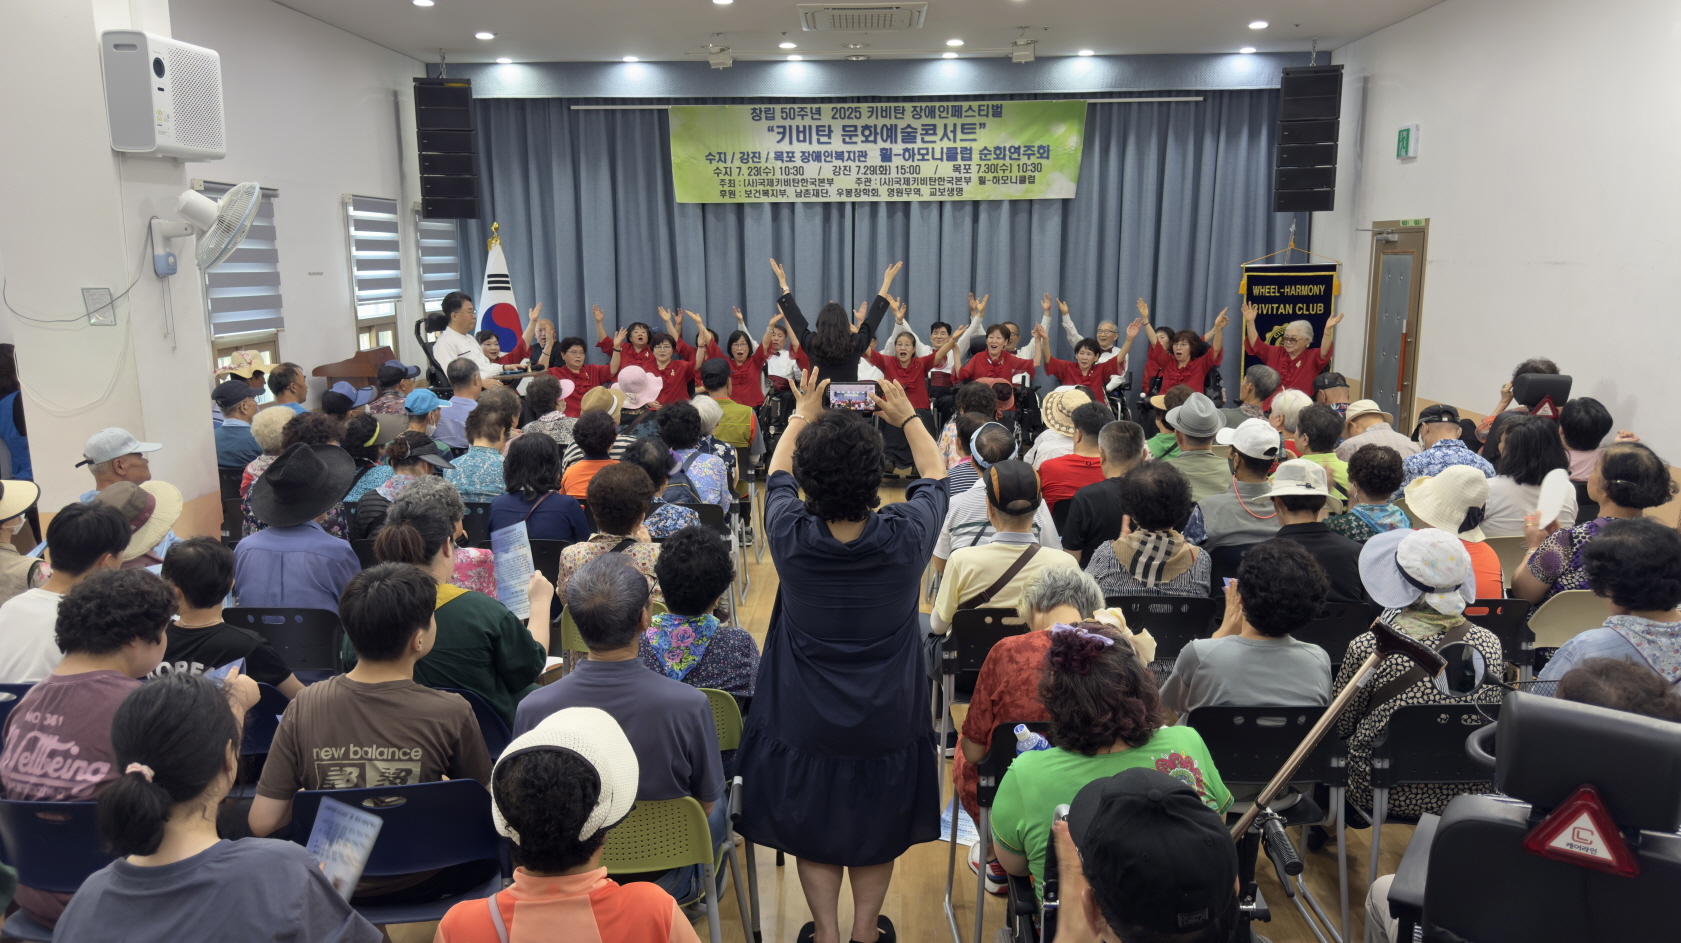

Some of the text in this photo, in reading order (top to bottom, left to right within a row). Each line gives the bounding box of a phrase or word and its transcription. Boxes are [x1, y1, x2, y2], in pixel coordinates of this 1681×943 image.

[750, 103, 1003, 121] 창립 50주년 2025 키비탄 장애인페스티벌
[705, 144, 1050, 164] 수지 / 강진 / 목포 장애인복지관 휠-하모니클럽 순회연주회
[713, 166, 732, 177] 수지
[779, 166, 804, 176] 10:30
[832, 165, 851, 176] 강진
[855, 165, 891, 176] 7.29(화)
[895, 164, 921, 175] 15:00
[952, 163, 972, 174] 목포
[976, 162, 1012, 174] 7.30(수)
[1016, 162, 1042, 173] 10:30
[719, 178, 736, 188] 주최
[743, 178, 834, 188] (사)국제키비탄한국본부
[855, 177, 872, 187] 주관
[879, 176, 972, 187] (사)국제키비탄한국본부
[978, 175, 1036, 185] 휠-하모니클럽
[719, 189, 736, 199] 후원
[744, 188, 789, 199] 보건복지부,
[836, 187, 881, 198] 우봉장학회,
[886, 187, 923, 197] 영원무역,
[929, 187, 964, 197] 교보생명
[1252, 285, 1326, 296] WHEEL-HARMONY
[1296, 303, 1324, 315] CLUB
[146, 661, 216, 680] ORE
[25, 711, 41, 723] NO
[313, 744, 423, 760] new balance
[1566, 842, 1597, 855] 케어라인
